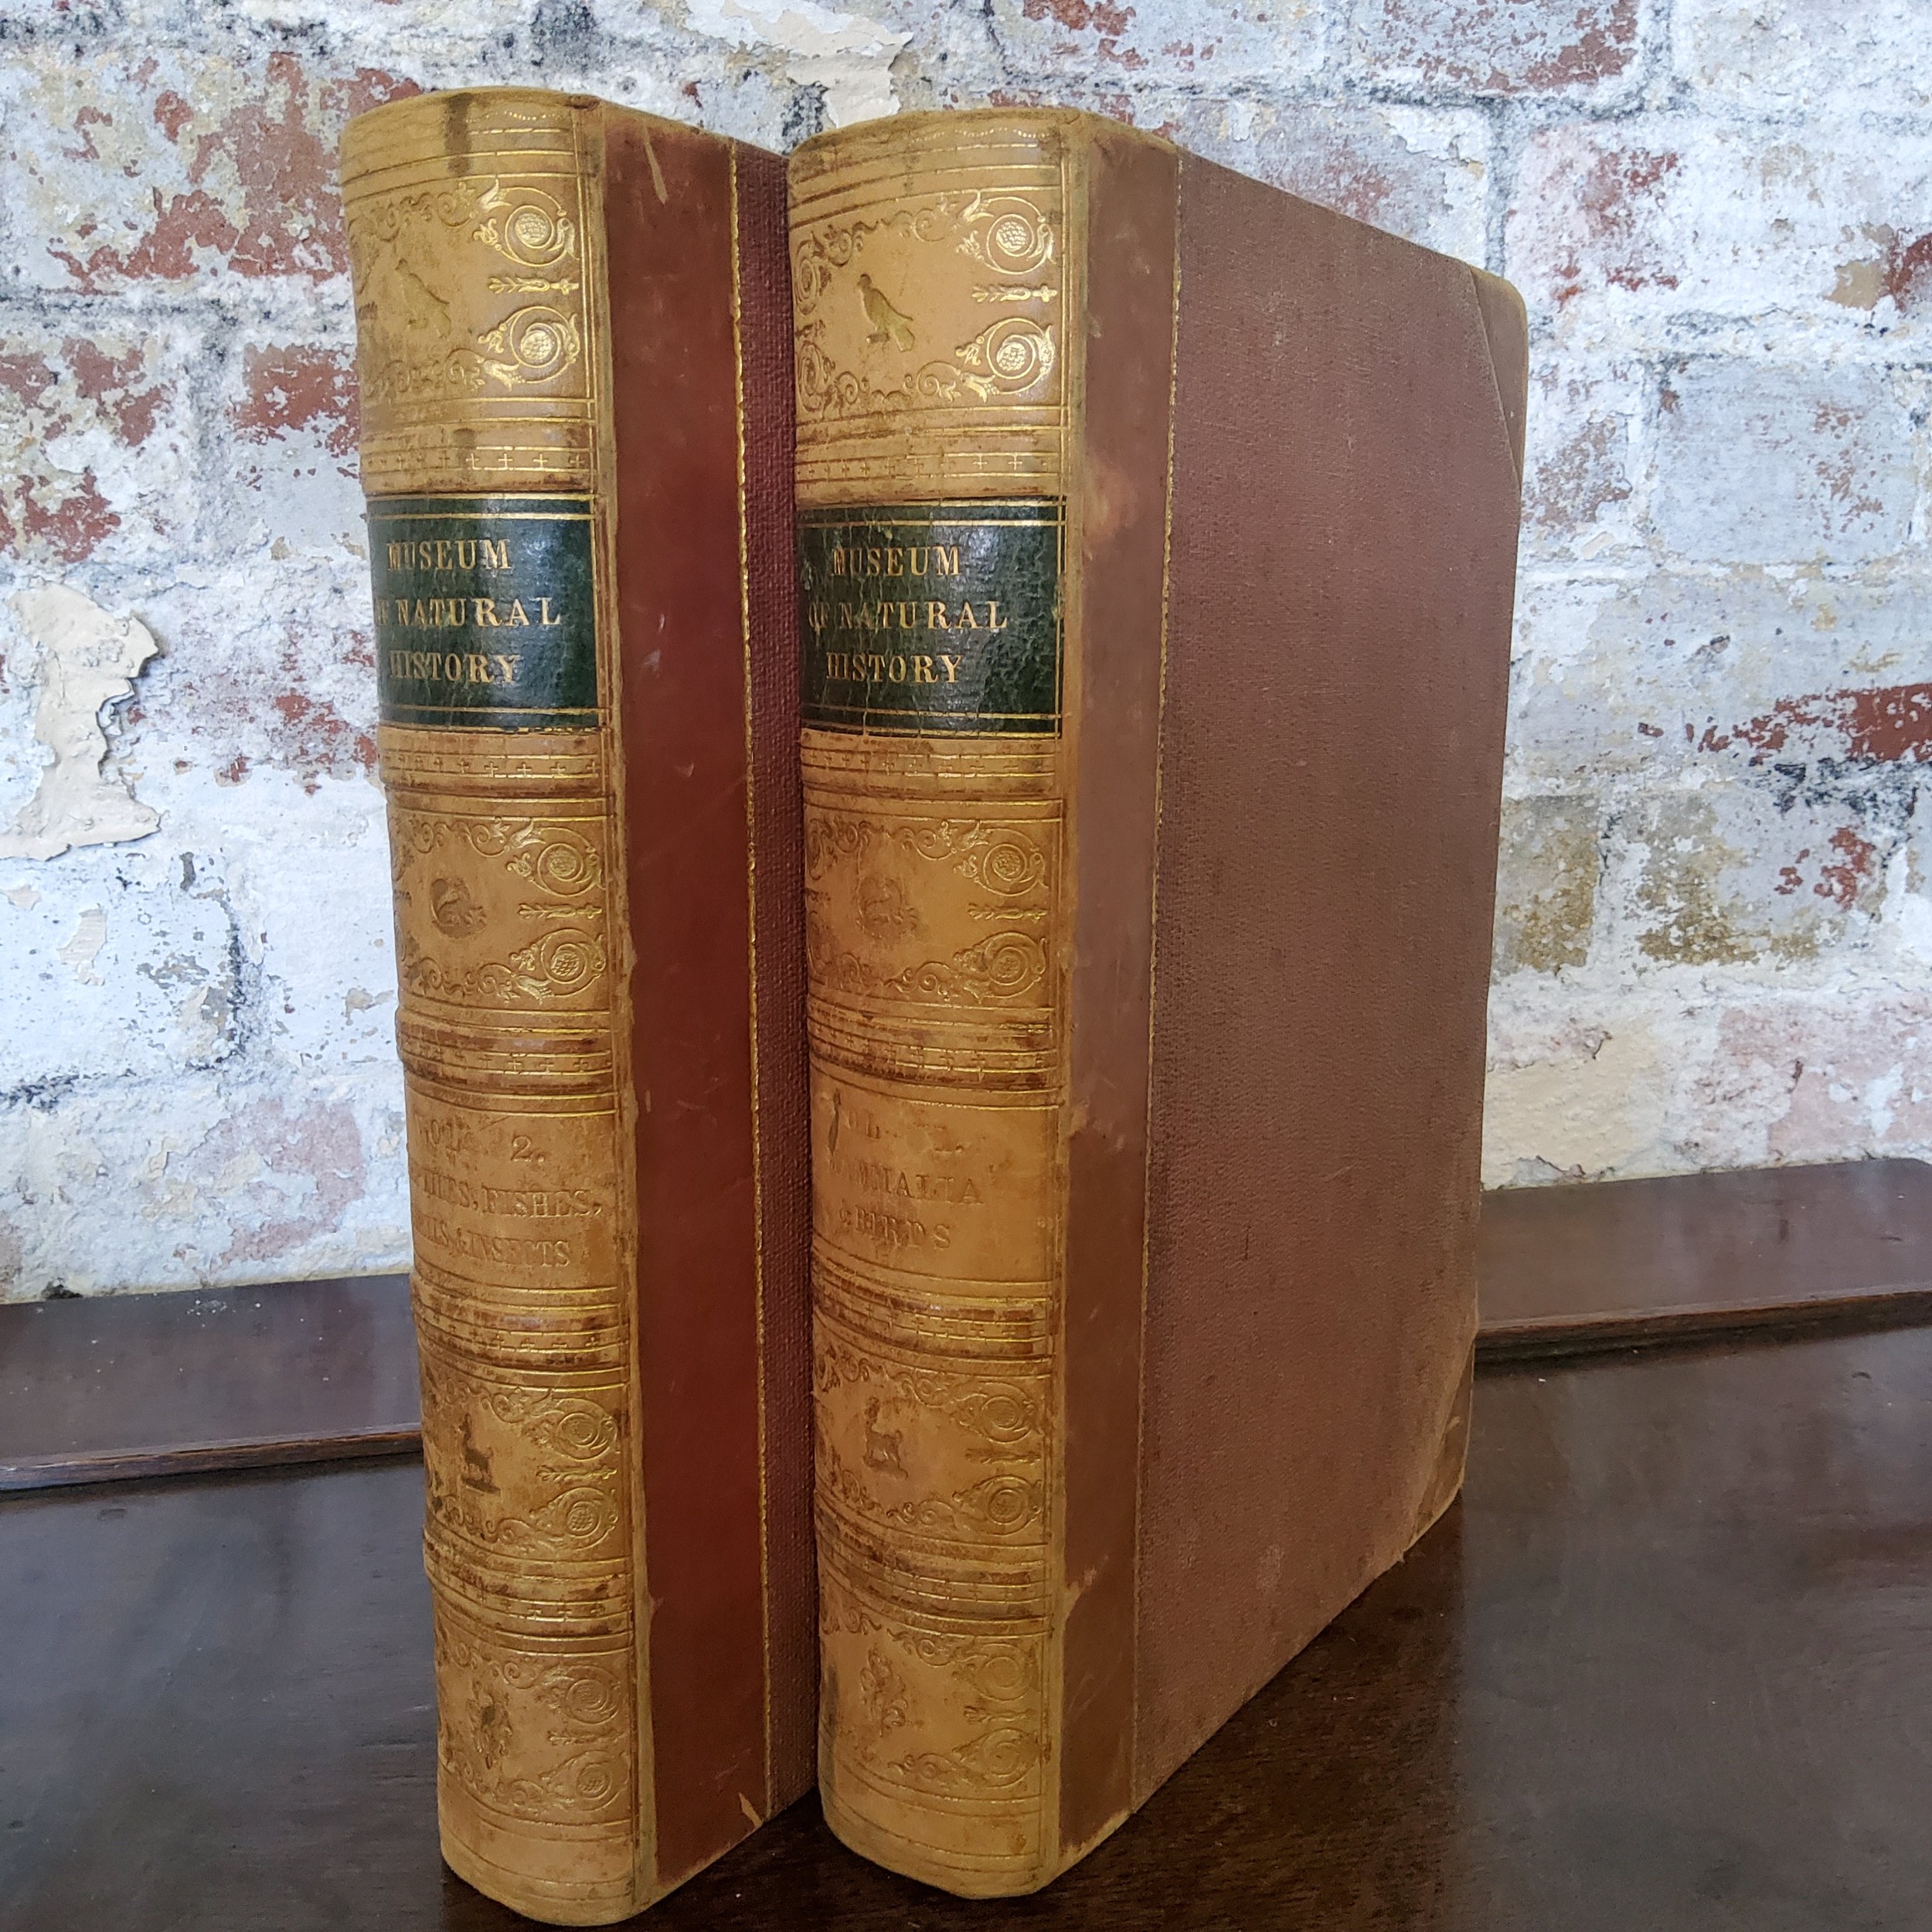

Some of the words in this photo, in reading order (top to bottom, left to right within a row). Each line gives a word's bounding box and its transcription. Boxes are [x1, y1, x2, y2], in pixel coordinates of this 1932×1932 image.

[387, 539, 512, 570] MUSEUM
[832, 544, 963, 577] MUSEUM
[395, 596, 562, 628] NATURAL
[838, 600, 1008, 630] NATURAL
[389, 649, 522, 683] HISTORY
[826, 652, 964, 684] HISTORY
[510, 1134, 546, 1163] 2.
